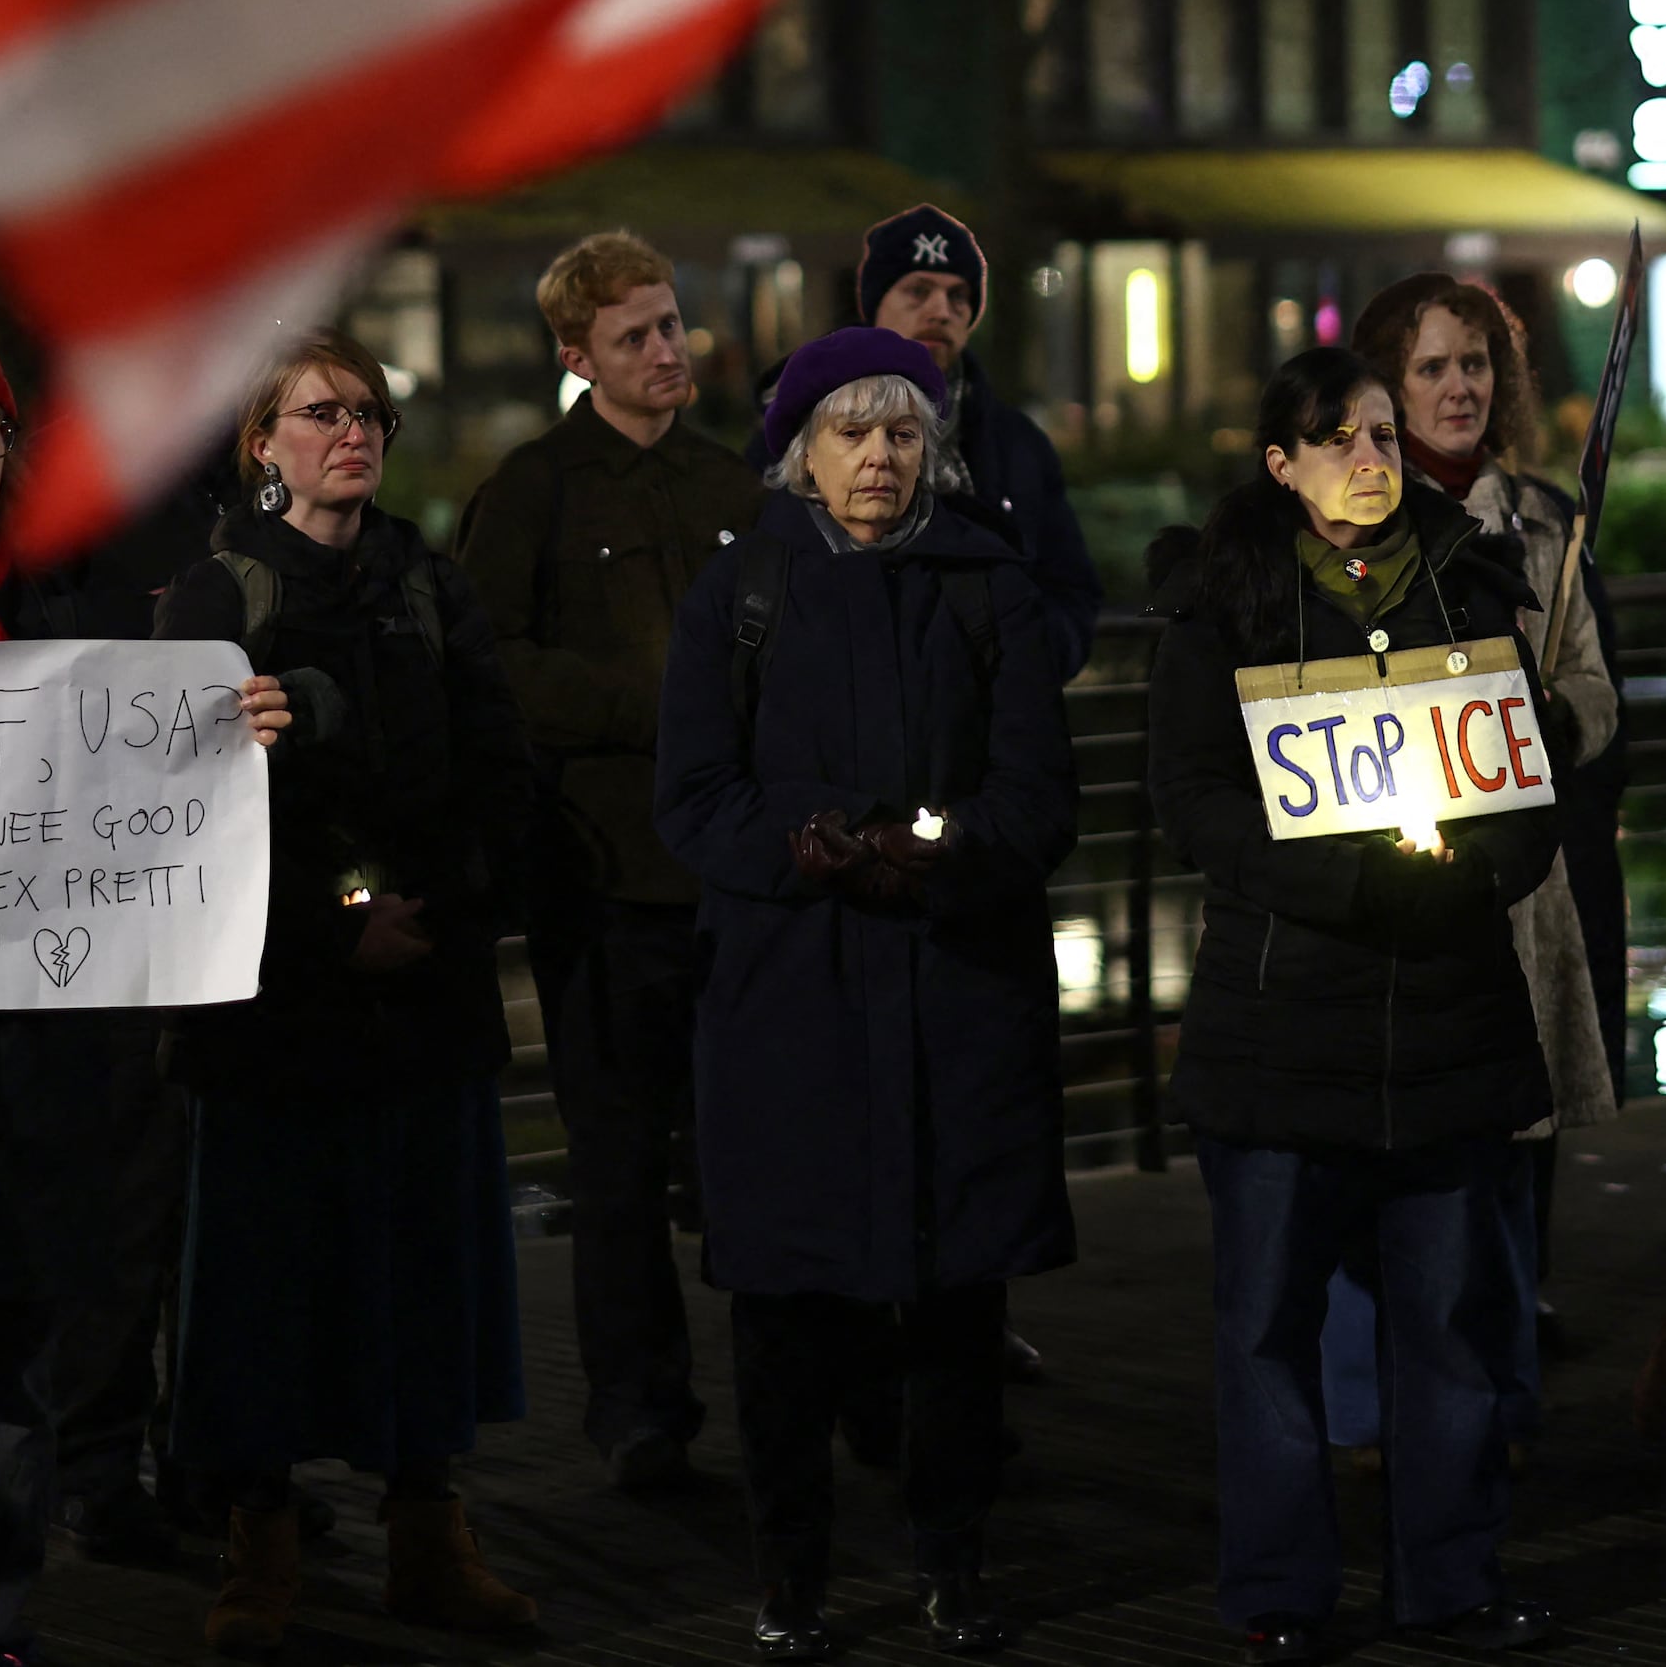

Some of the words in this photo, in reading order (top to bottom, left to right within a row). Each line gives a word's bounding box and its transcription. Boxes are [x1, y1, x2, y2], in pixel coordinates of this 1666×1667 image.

[913, 233, 949, 265] NY
[79, 685, 244, 758] USA?
[1430, 697, 1543, 799] ICE
[92, 798, 206, 852] GOOD
[64, 864, 206, 910] PRETTI
